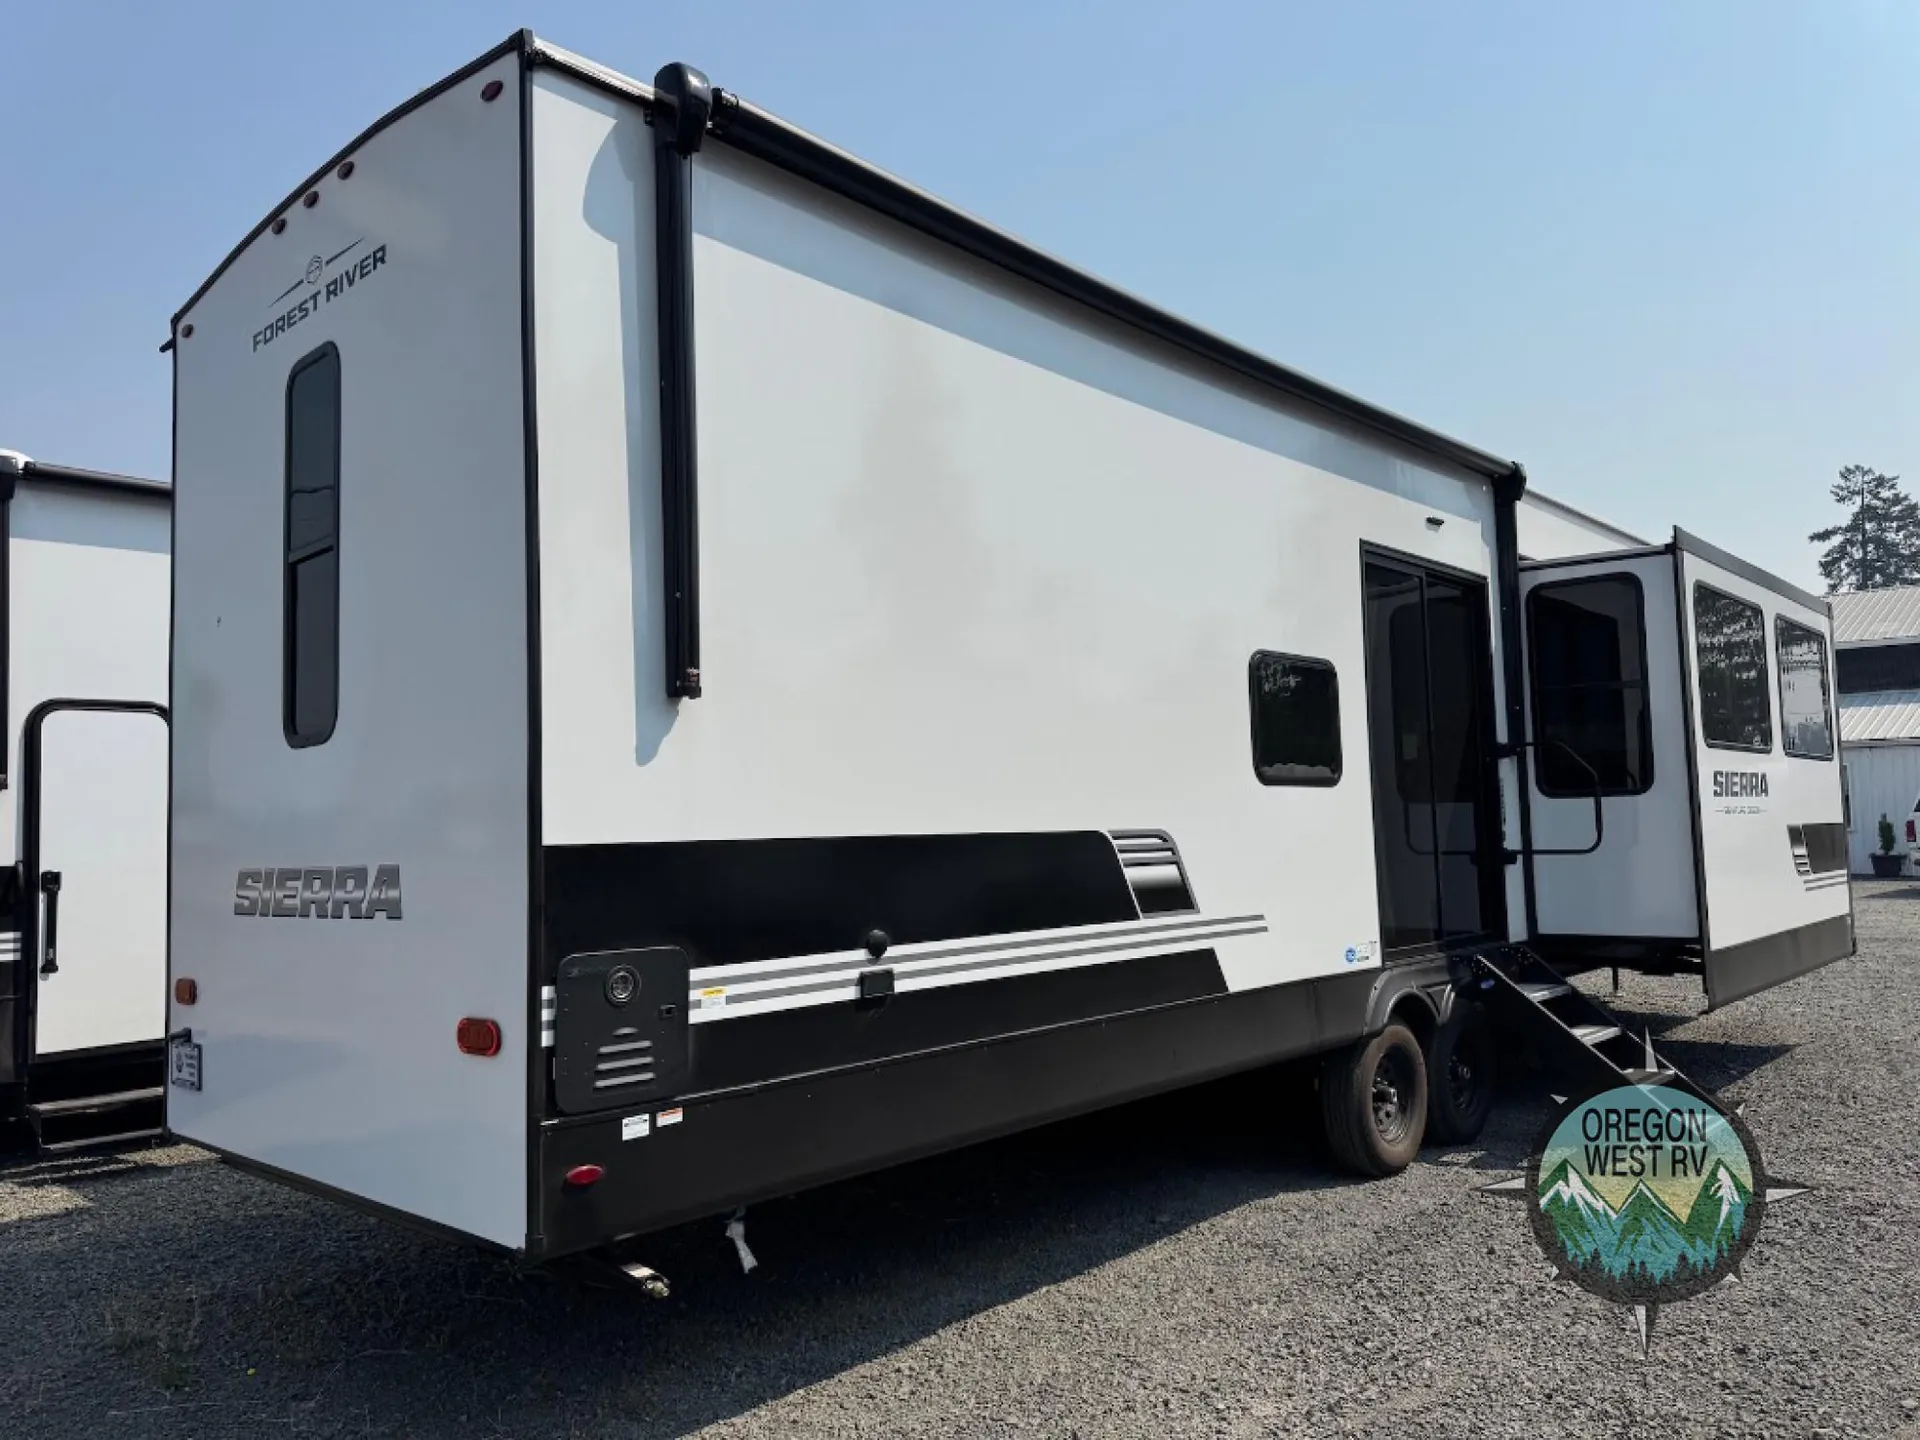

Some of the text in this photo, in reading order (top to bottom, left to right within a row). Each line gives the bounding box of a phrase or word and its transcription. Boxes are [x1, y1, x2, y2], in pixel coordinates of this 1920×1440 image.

[252, 243, 387, 353] FOREST RIVER
[1713, 770, 1769, 798] SIERRA
[234, 864, 402, 920] SIERRA
